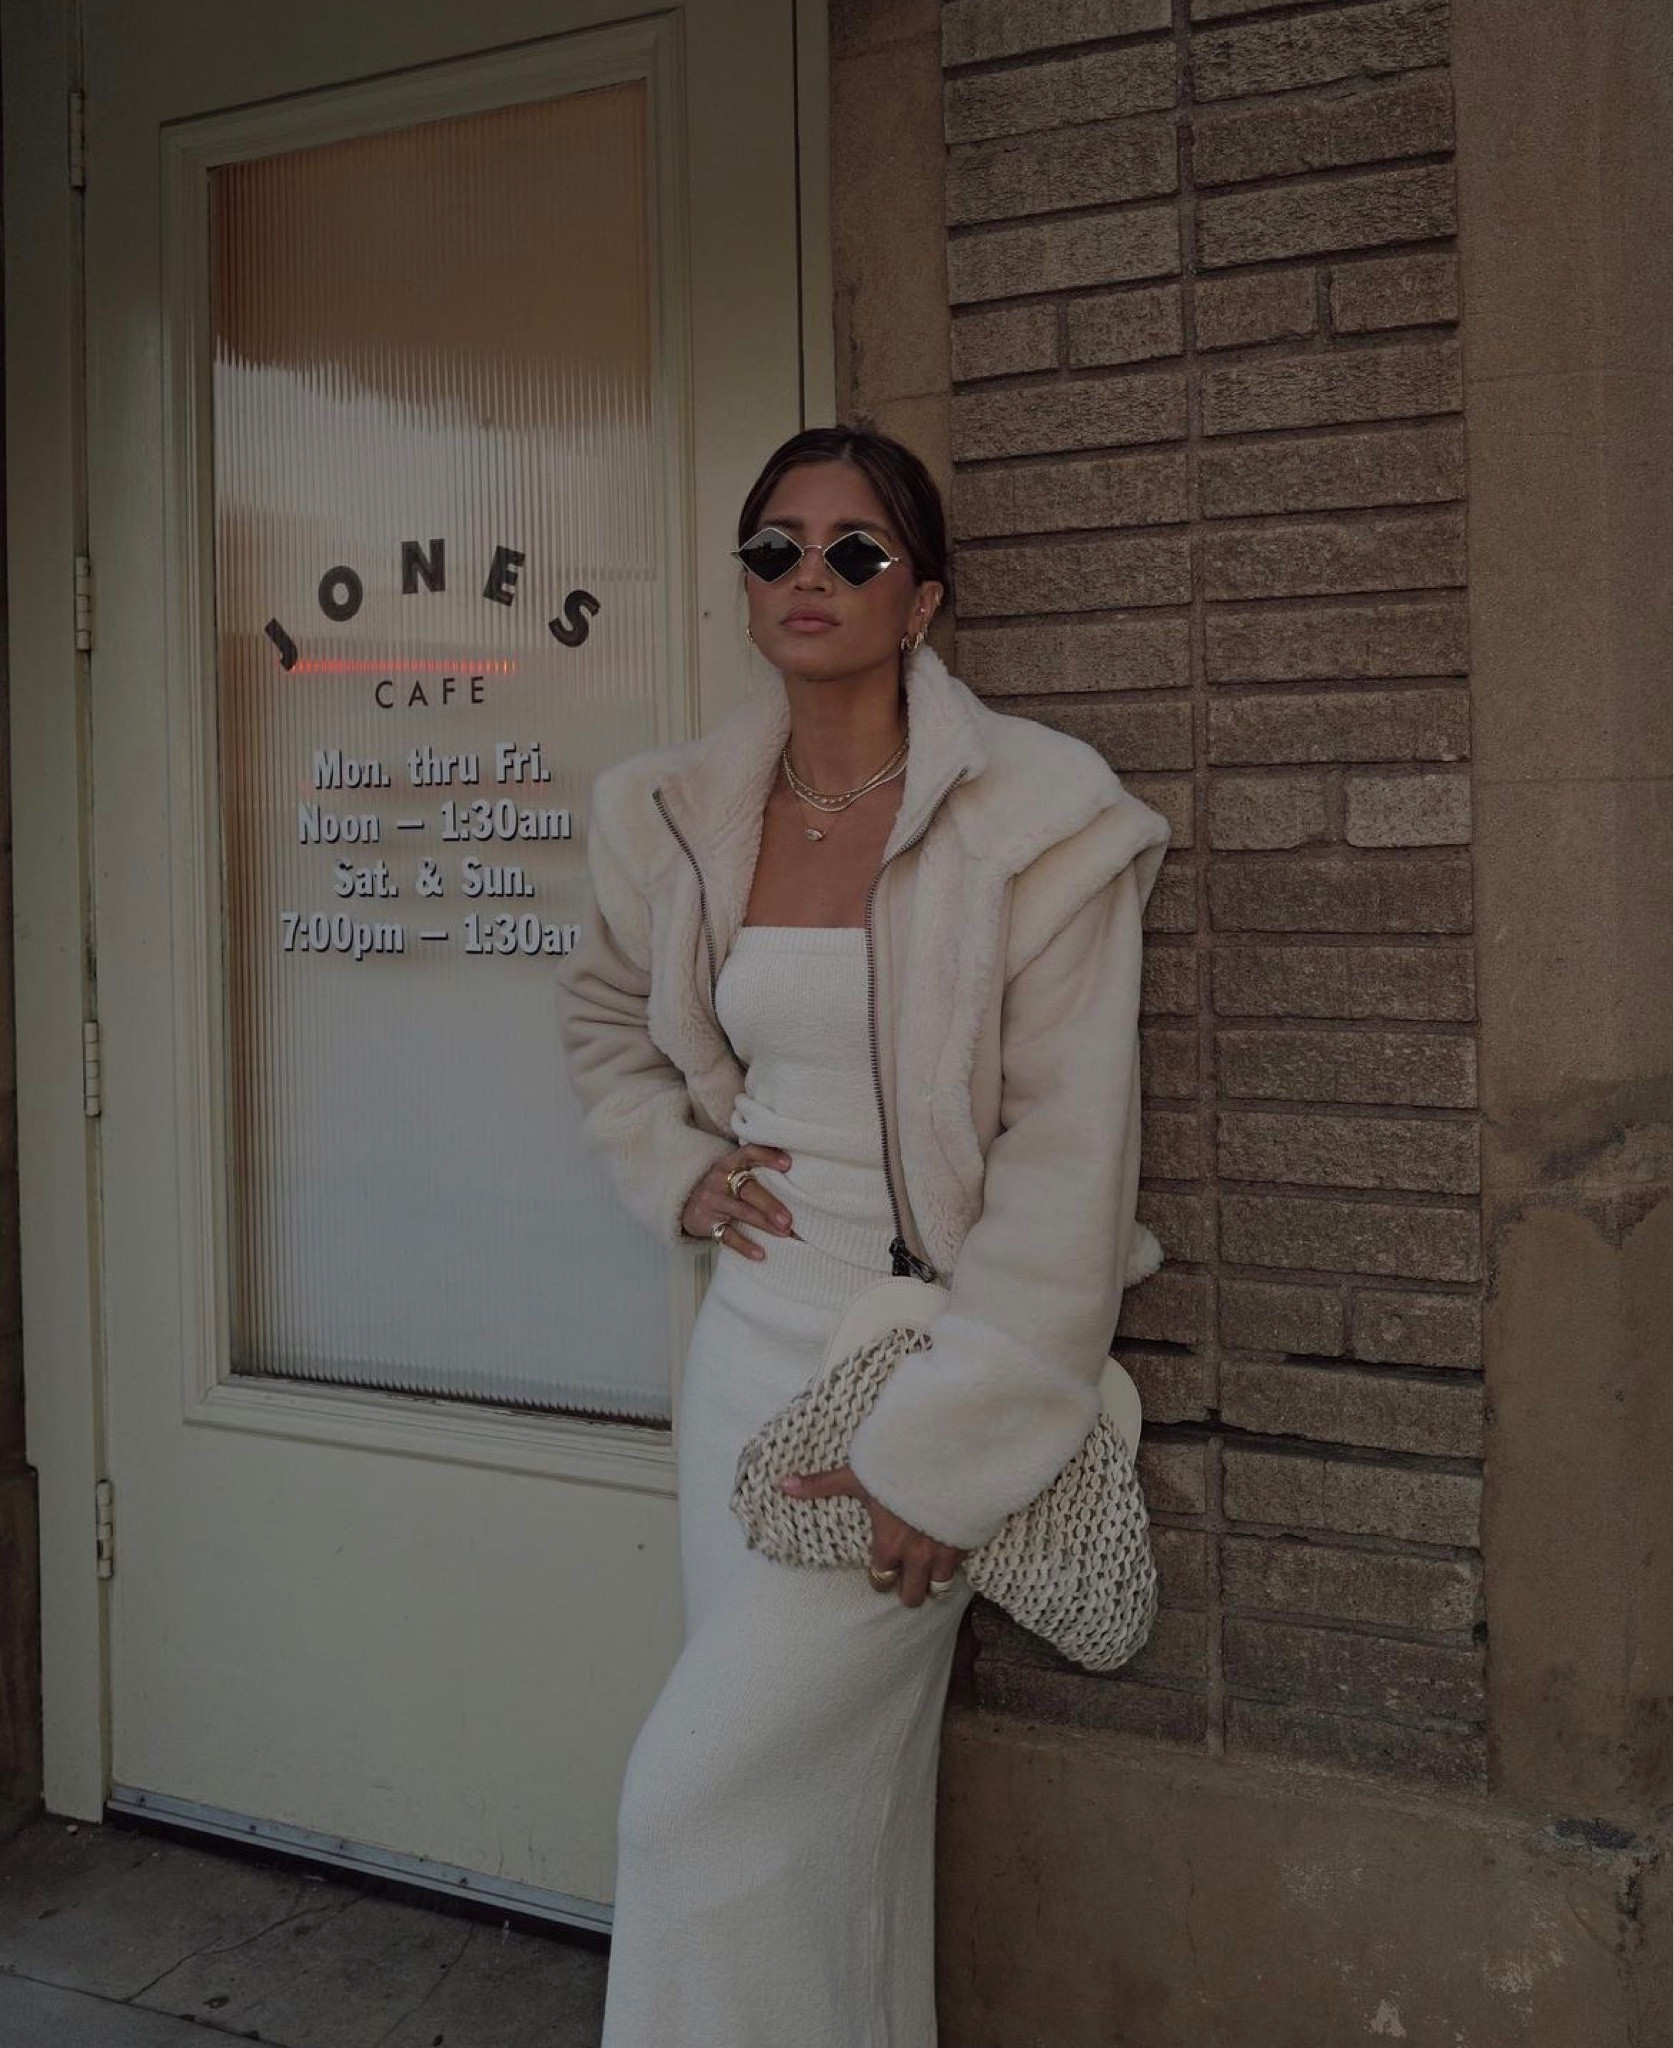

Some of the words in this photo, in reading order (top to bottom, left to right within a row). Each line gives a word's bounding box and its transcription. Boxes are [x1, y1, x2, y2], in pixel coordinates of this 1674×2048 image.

[264, 538, 600, 671] JONES
[375, 676, 486, 708] CAFE
[312, 749, 390, 788] Mon.
[407, 744, 480, 786] thru
[495, 742, 551, 783] Fri.
[299, 803, 379, 843] Noon
[440, 799, 571, 841] 1:30am
[333, 857, 398, 898] Sat.
[415, 856, 444, 897] &
[461, 856, 534, 898] Sun.
[280, 912, 402, 960] 7:00pm
